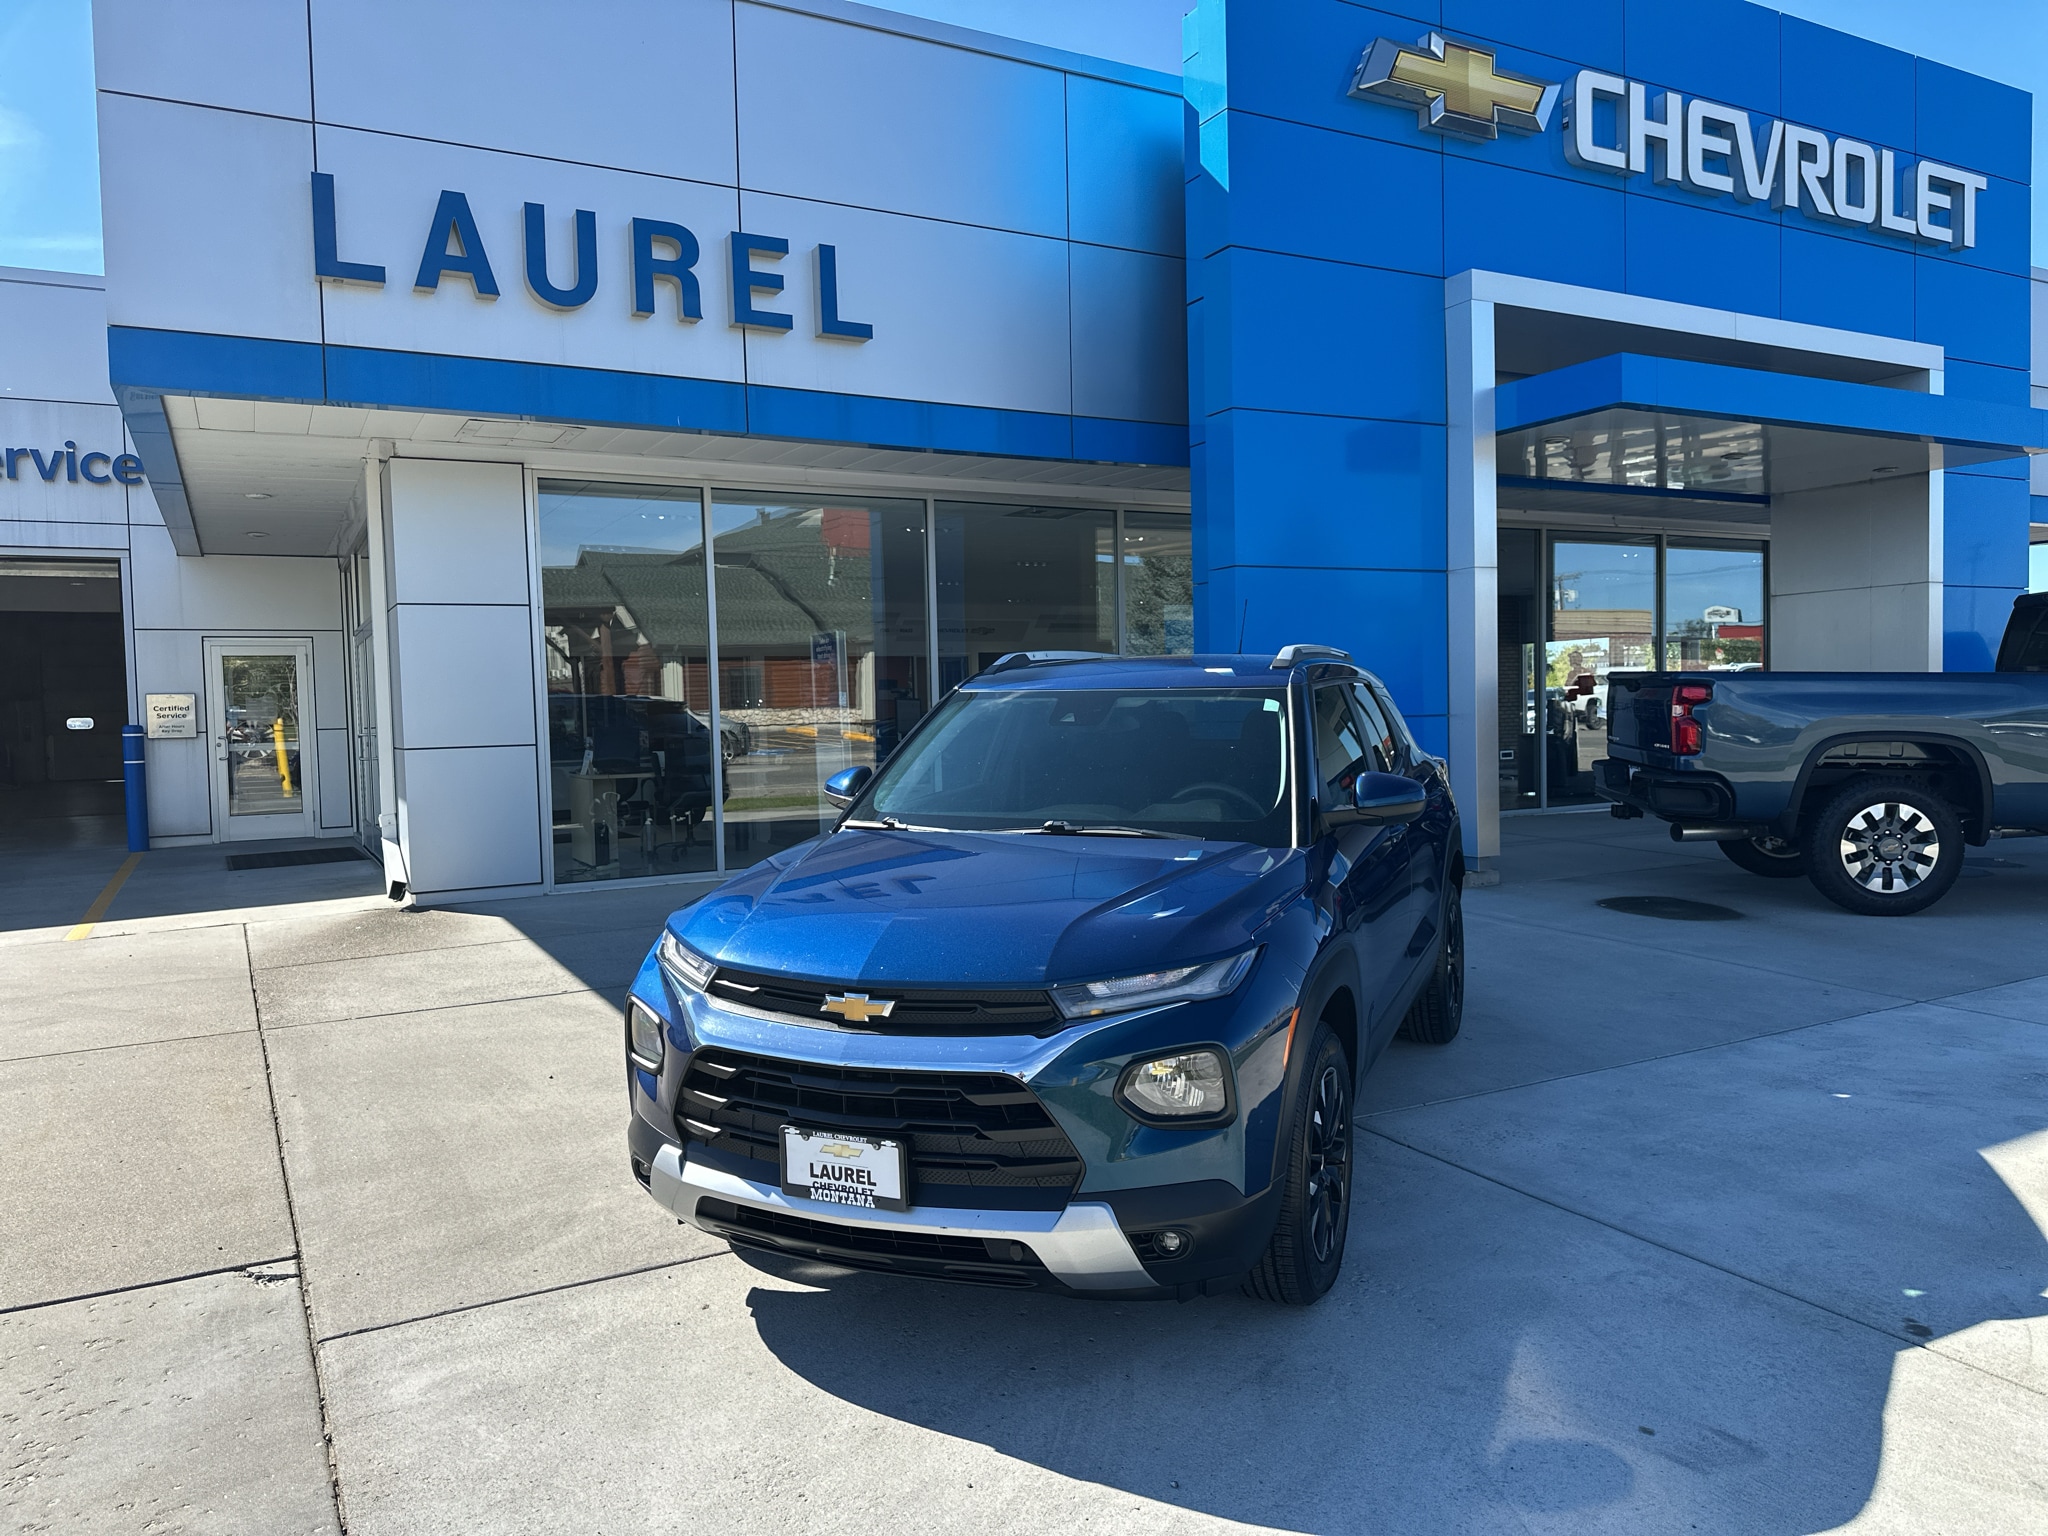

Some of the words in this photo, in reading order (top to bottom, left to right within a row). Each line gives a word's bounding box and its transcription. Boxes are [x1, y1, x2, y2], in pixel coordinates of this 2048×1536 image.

[1567, 69, 1988, 249] CHEVROLET
[311, 171, 874, 343] LAUREL
[0, 440, 145, 484] rvice
[812, 1131, 833, 1140] LAUREL
[833, 1134, 868, 1144] CHEVROLET
[809, 1162, 877, 1187] LAUREL
[810, 1187, 876, 1209] MONTANA
